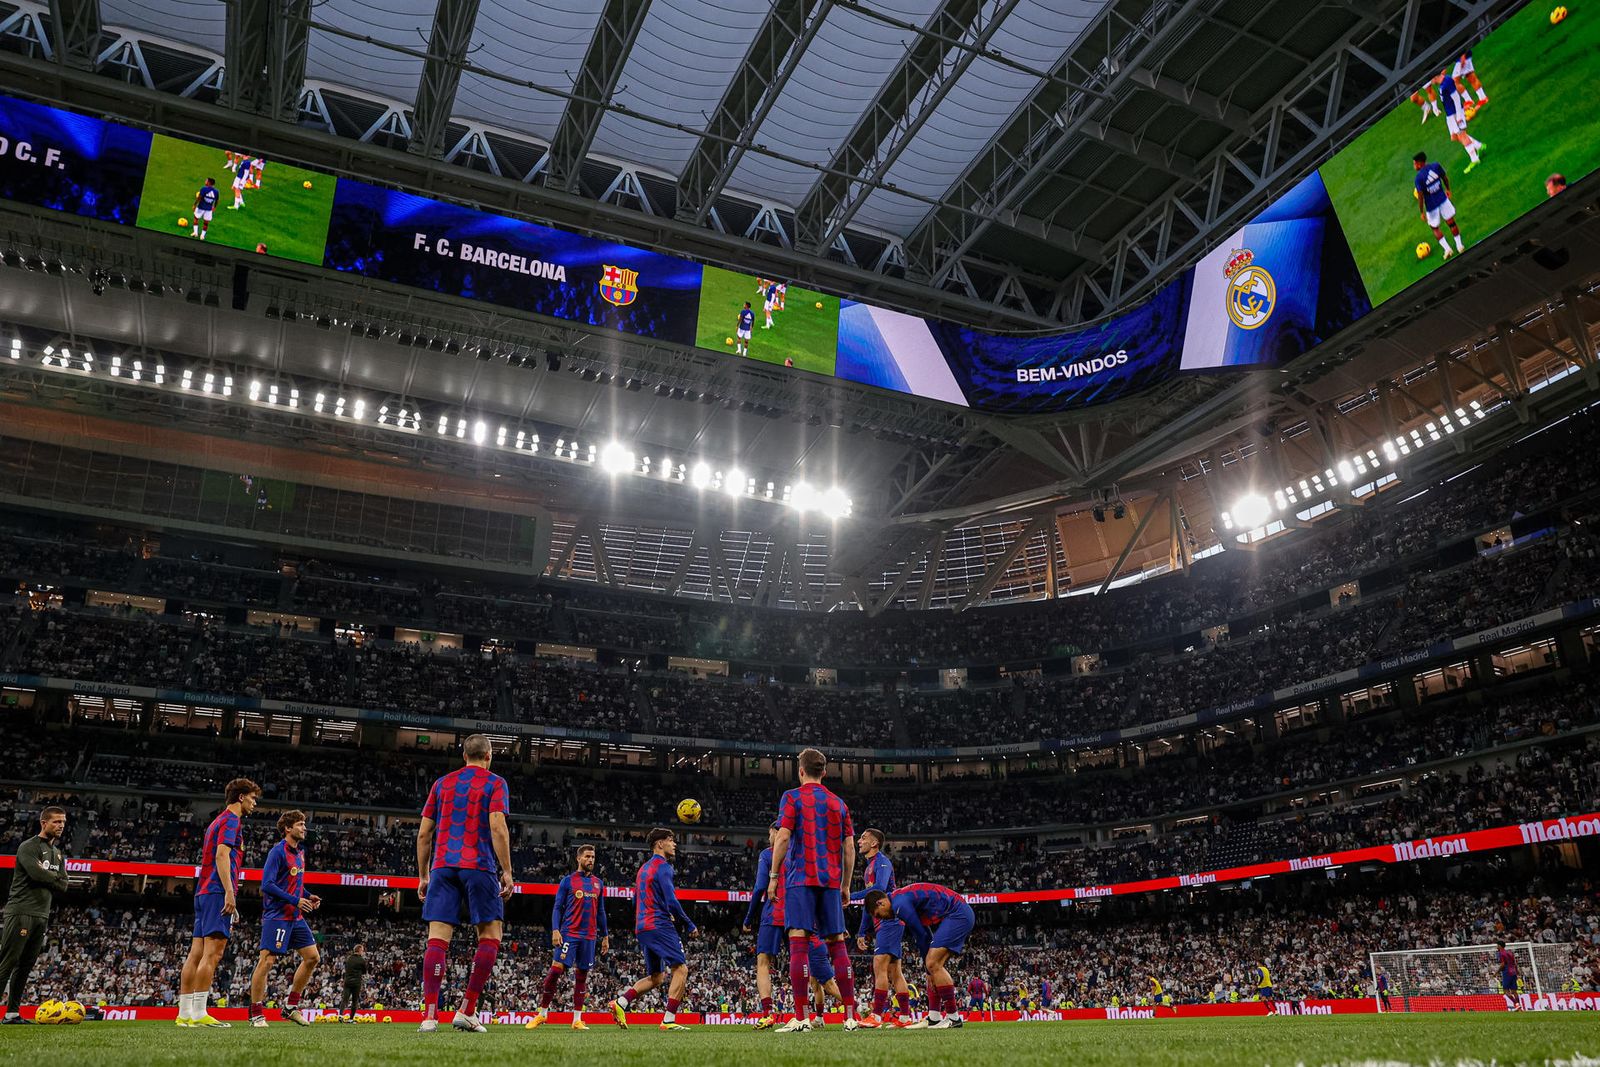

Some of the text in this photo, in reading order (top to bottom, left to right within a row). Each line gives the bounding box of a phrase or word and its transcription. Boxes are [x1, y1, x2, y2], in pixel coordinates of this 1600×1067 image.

[15, 141, 37, 163] C.
[44, 147, 65, 170] F.
[413, 232, 567, 283] F. C. BARCELONA
[1016, 349, 1129, 382] BEM-VINDOS
[1479, 620, 1536, 643] Real Madrid
[1380, 650, 1430, 670] Real Madrid
[74, 683, 130, 695] Real Madrid
[1392, 838, 1470, 862] Mahou
[64, 859, 92, 872] hou
[1289, 857, 1332, 871] Mahou
[340, 873, 389, 888] Mahou
[1179, 873, 1217, 886] Mahou
[1074, 887, 1113, 898] Mahou
